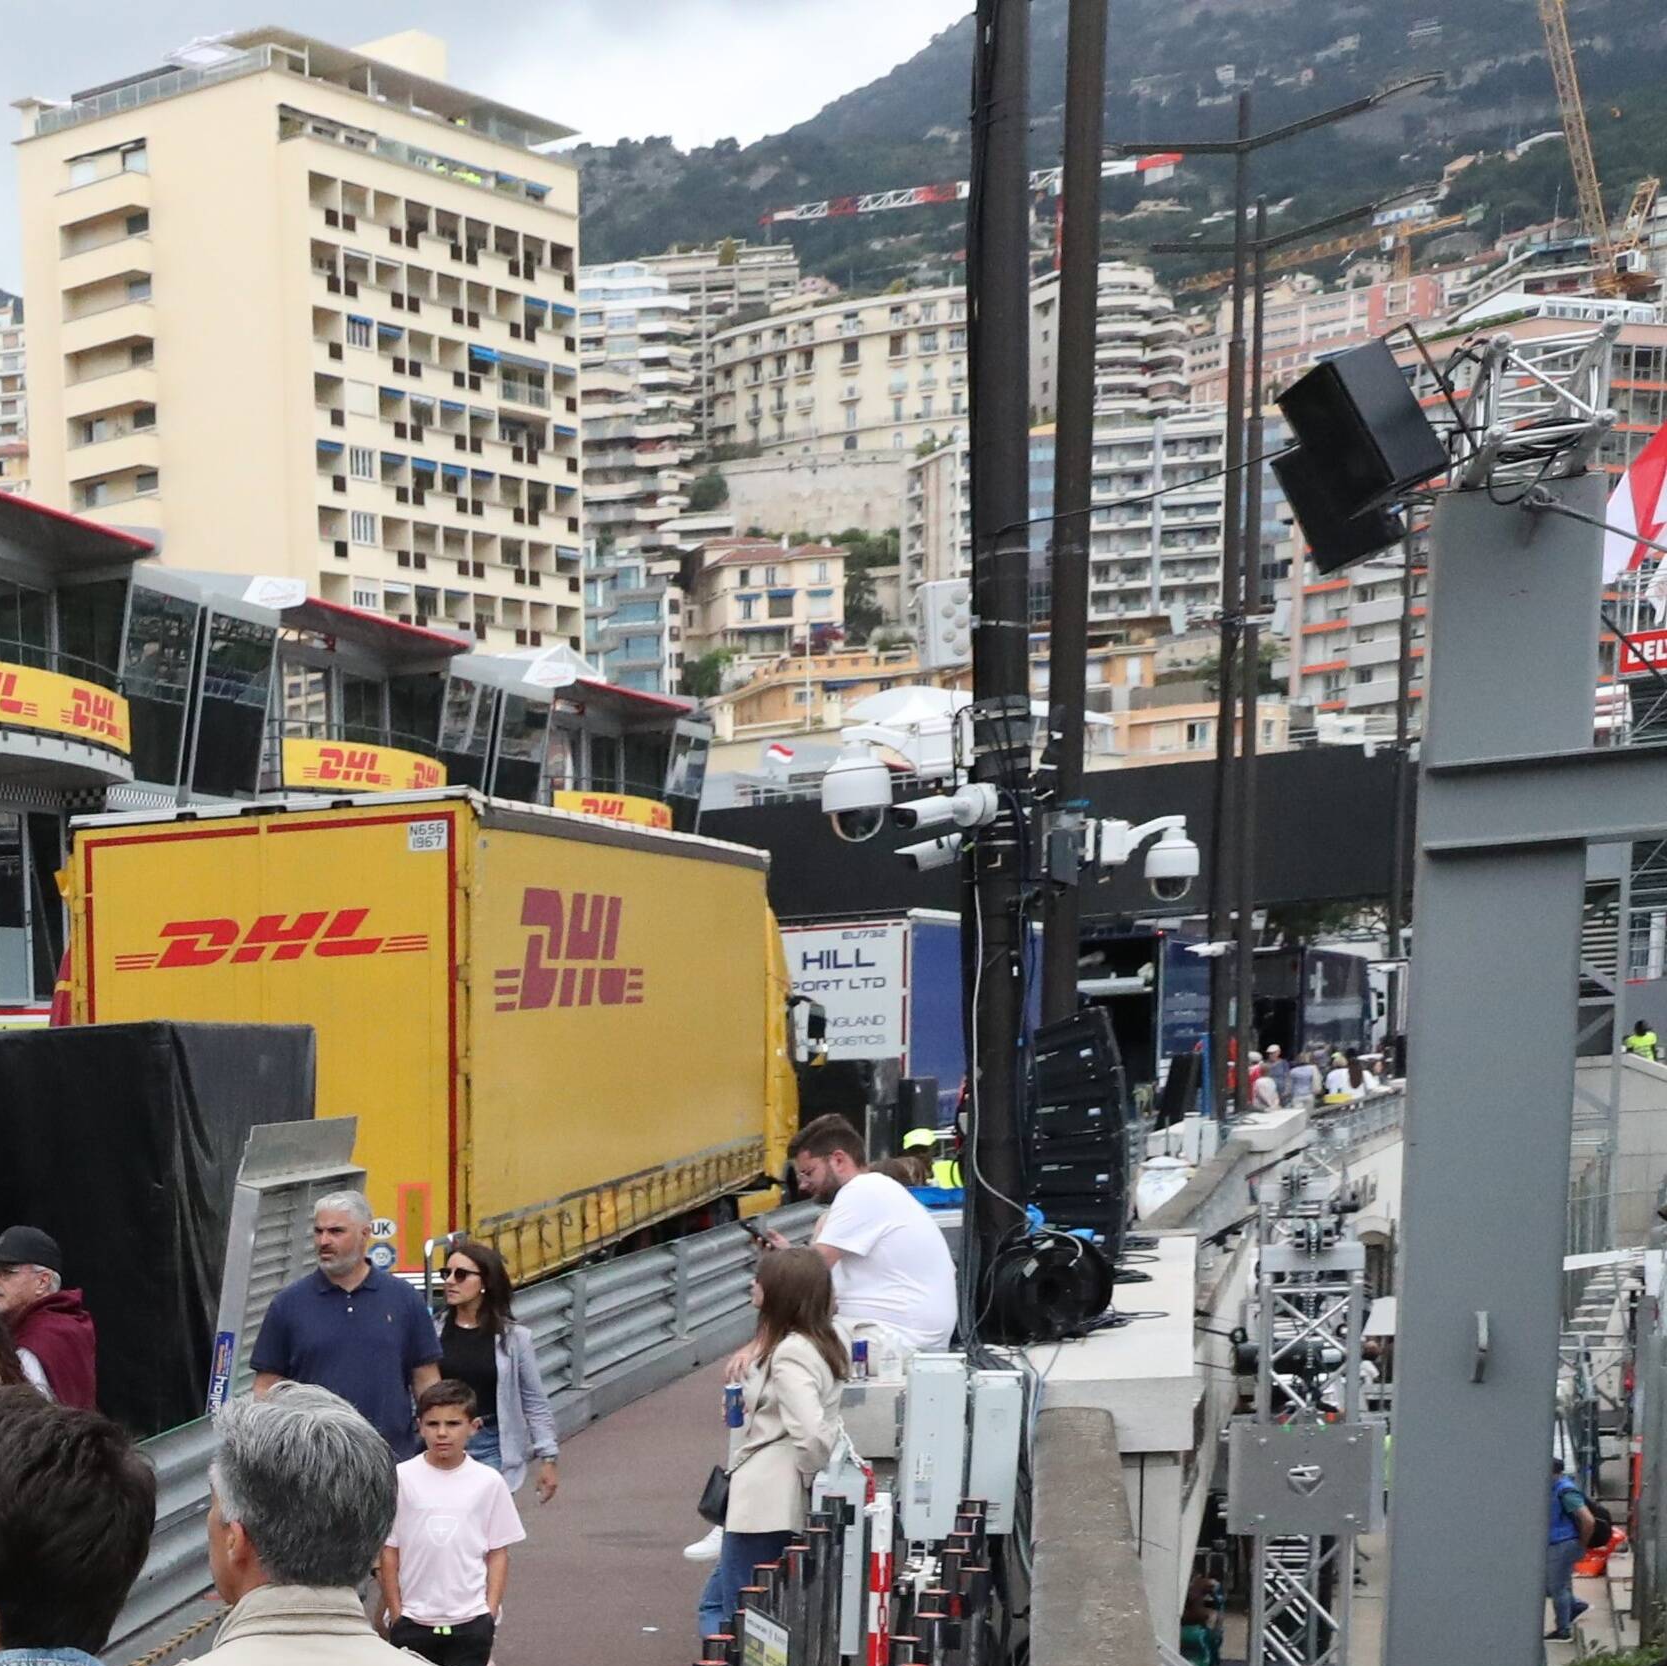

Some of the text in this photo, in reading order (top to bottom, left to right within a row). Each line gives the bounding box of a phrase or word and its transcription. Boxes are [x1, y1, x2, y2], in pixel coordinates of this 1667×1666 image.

[1627, 637, 1667, 664] DEL
[72, 688, 124, 739] DHL
[318, 748, 381, 784] DHL
[409, 822, 445, 836] N656
[412, 835, 443, 849] 1967
[155, 908, 384, 968] DHL
[518, 886, 627, 1010] DHL
[802, 948, 876, 970] HILL
[849, 977, 886, 989] LTD
[372, 1222, 391, 1235] UK
